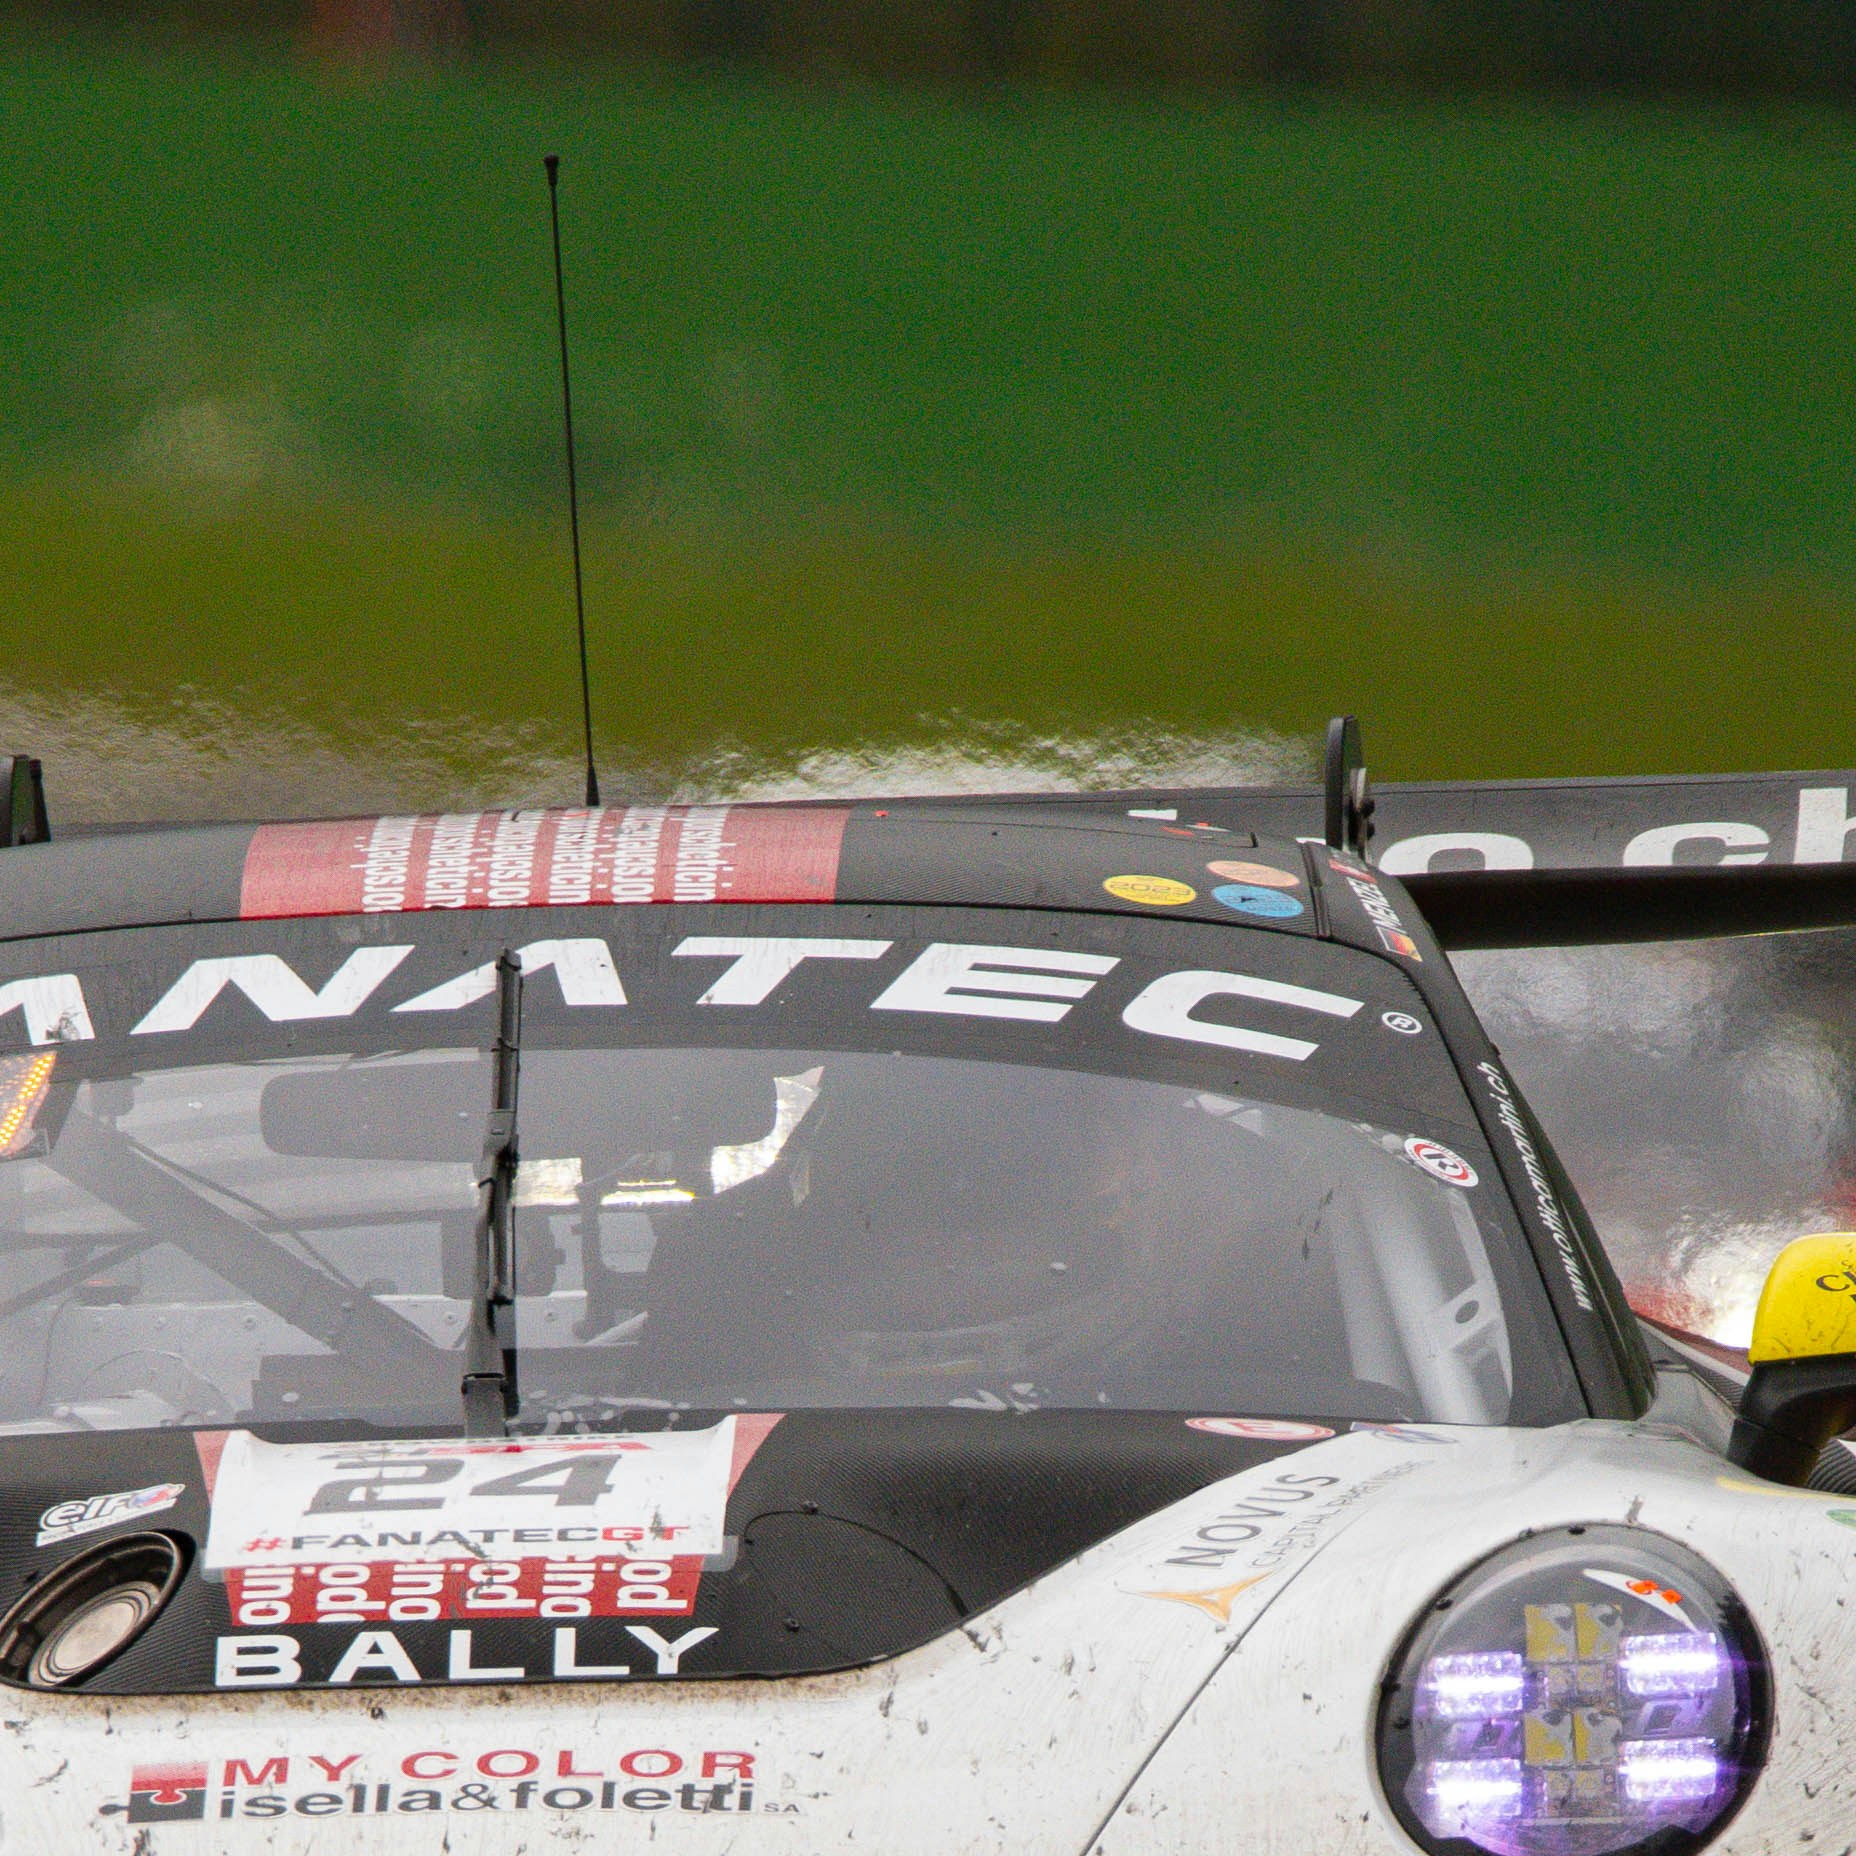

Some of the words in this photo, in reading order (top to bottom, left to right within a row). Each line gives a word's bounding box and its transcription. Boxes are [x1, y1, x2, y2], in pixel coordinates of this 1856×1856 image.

[1109, 880, 1192, 898] 2023
[302, 1453, 623, 1516] 24
[1164, 1473, 1340, 1568] NOVUS
[214, 1626, 719, 1687] BALLY
[222, 1754, 364, 1787] MY
[400, 1749, 757, 1782] COLOR
[219, 1779, 755, 1819] isella&foletti
[763, 1802, 801, 1815] SA
